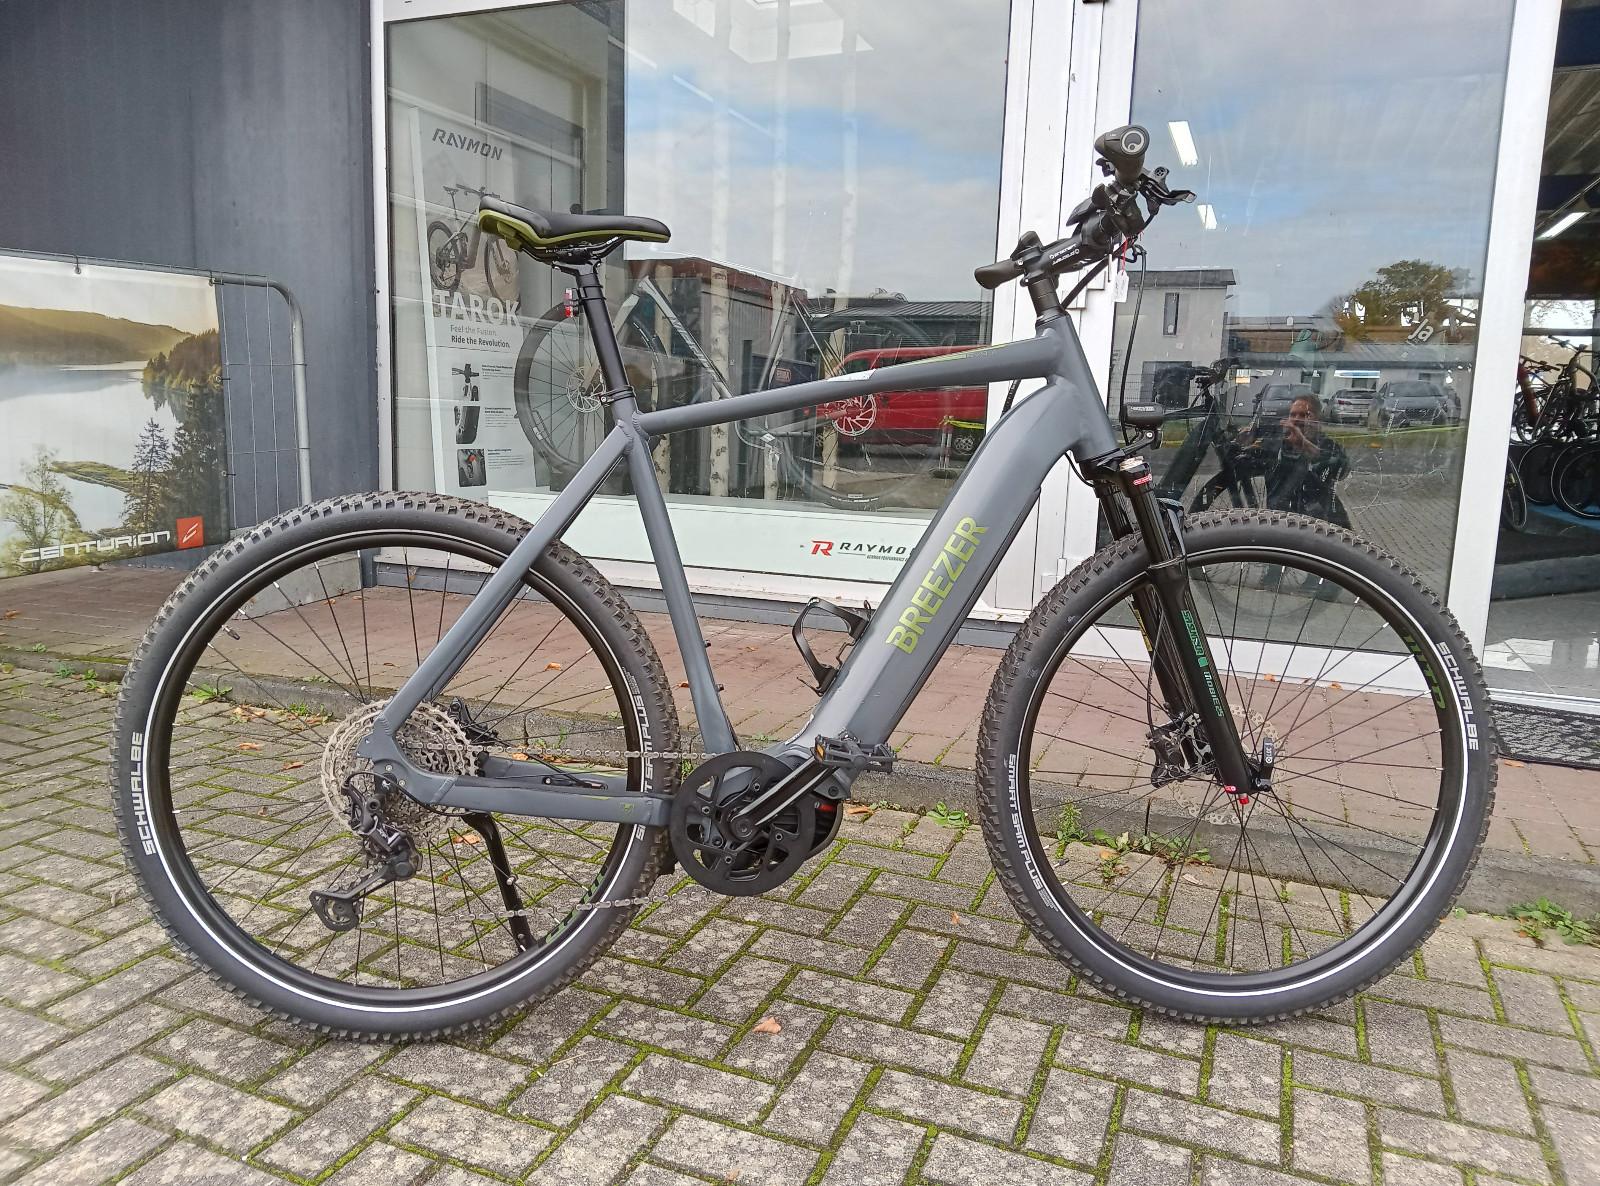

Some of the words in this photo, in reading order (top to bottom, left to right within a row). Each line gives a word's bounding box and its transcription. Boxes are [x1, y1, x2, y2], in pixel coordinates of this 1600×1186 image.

[432, 128, 503, 160] RAYMON
[433, 288, 520, 327] TAROK
[451, 335, 465, 344] Ride
[466, 336, 477, 345] the
[885, 516, 990, 654] BREEZER
[633, 695, 652, 739] PLUS
[1436, 641, 1479, 751] SCHWALBE
[130, 731, 157, 856] SCHWALBE
[1008, 753, 1018, 811] SMART
[1011, 812, 1026, 849] SAM
[1020, 850, 1043, 890] PLUS
